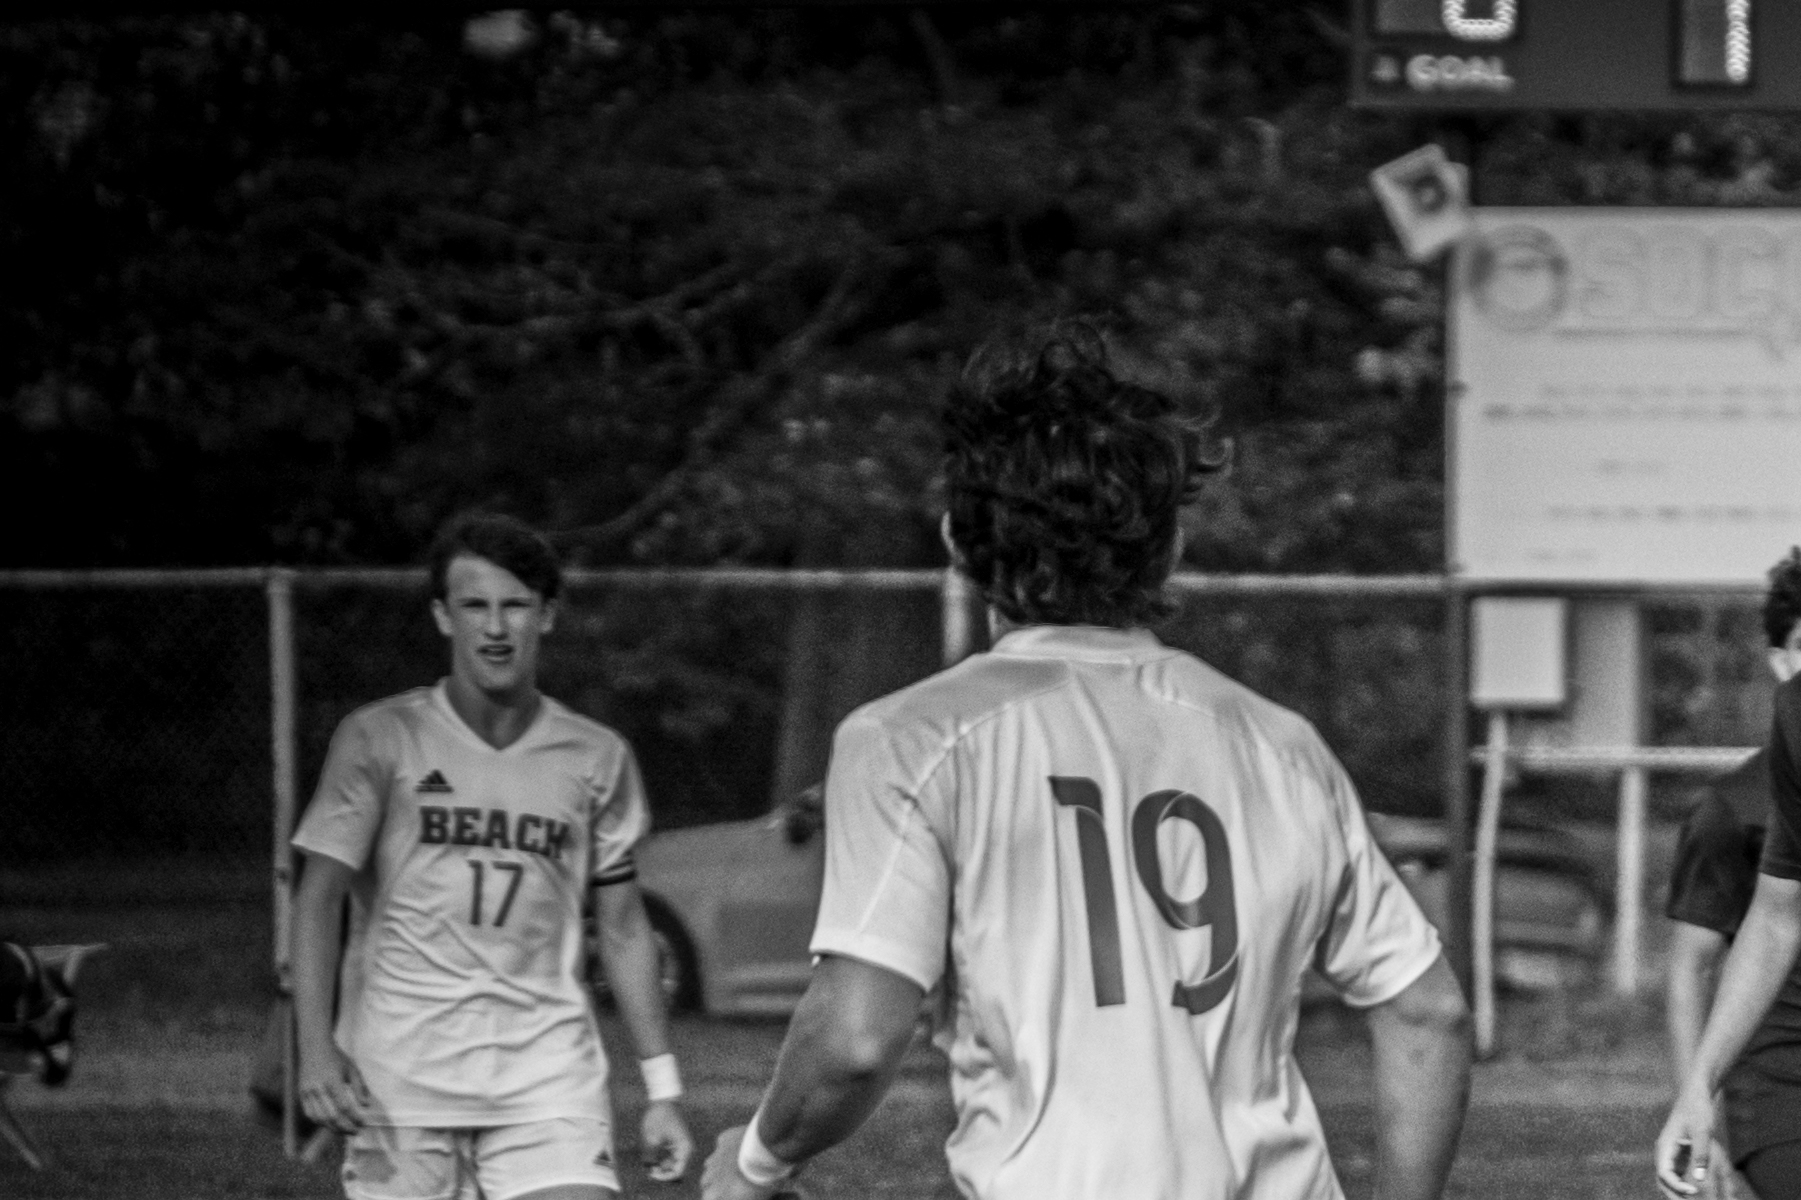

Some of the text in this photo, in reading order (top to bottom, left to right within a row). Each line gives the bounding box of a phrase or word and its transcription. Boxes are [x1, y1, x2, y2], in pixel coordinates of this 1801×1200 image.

[1406, 53, 1516, 94] GOAL
[420, 804, 572, 859] BEACH
[467, 859, 524, 927] 17
[1046, 774, 1239, 1016] 19
